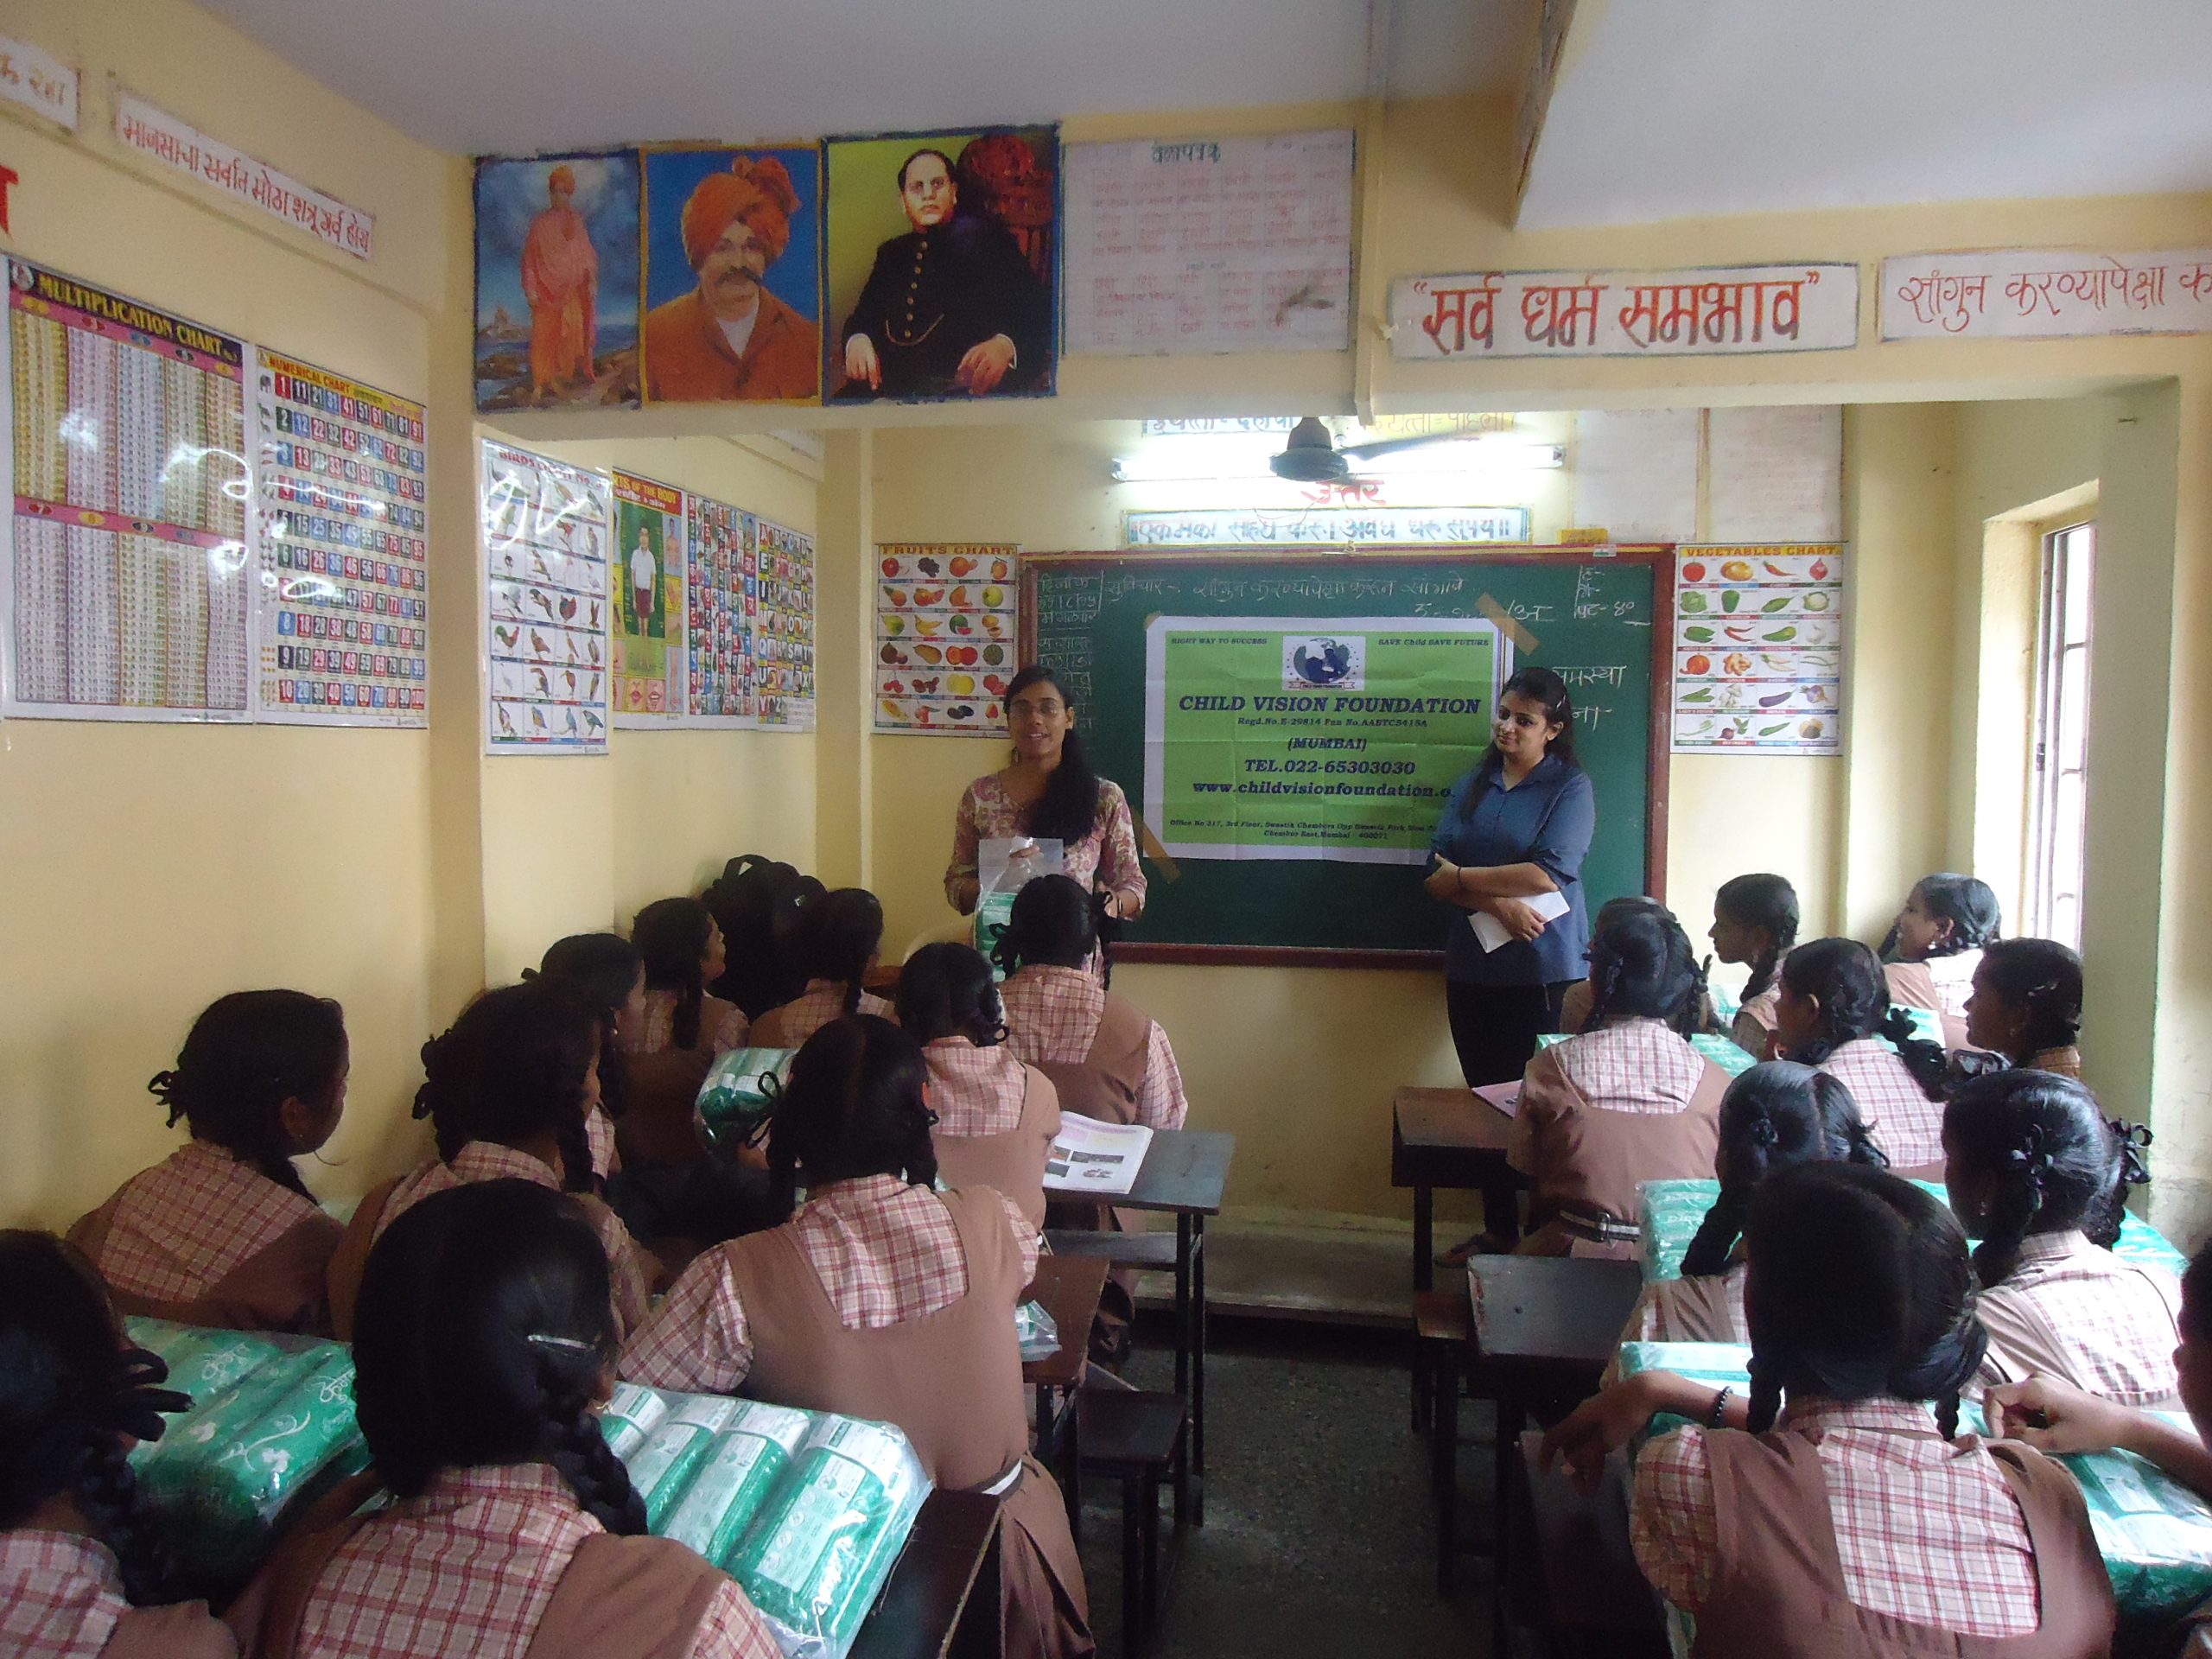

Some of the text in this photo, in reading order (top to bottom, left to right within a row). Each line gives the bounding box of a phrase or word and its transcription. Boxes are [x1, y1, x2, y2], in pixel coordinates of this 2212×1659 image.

[39, 274, 223, 356] MULTIPLICATION CHART
[1521, 273, 1610, 347] धर्म
[270, 356, 322, 385] NUMERICAL
[323, 375, 350, 394] CHART
[883, 545, 1012, 555] FRUITS CHART
[1687, 545, 1835, 556] VEGETABLES CHART
[1179, 696, 1482, 715] CHILD VISION FOUNDATION
[1287, 737, 1367, 752] (MUMBAI)
[1244, 760, 1416, 775] TEL.022-65303030
[1193, 780, 1456, 798] www.childvisionfoundation.o
